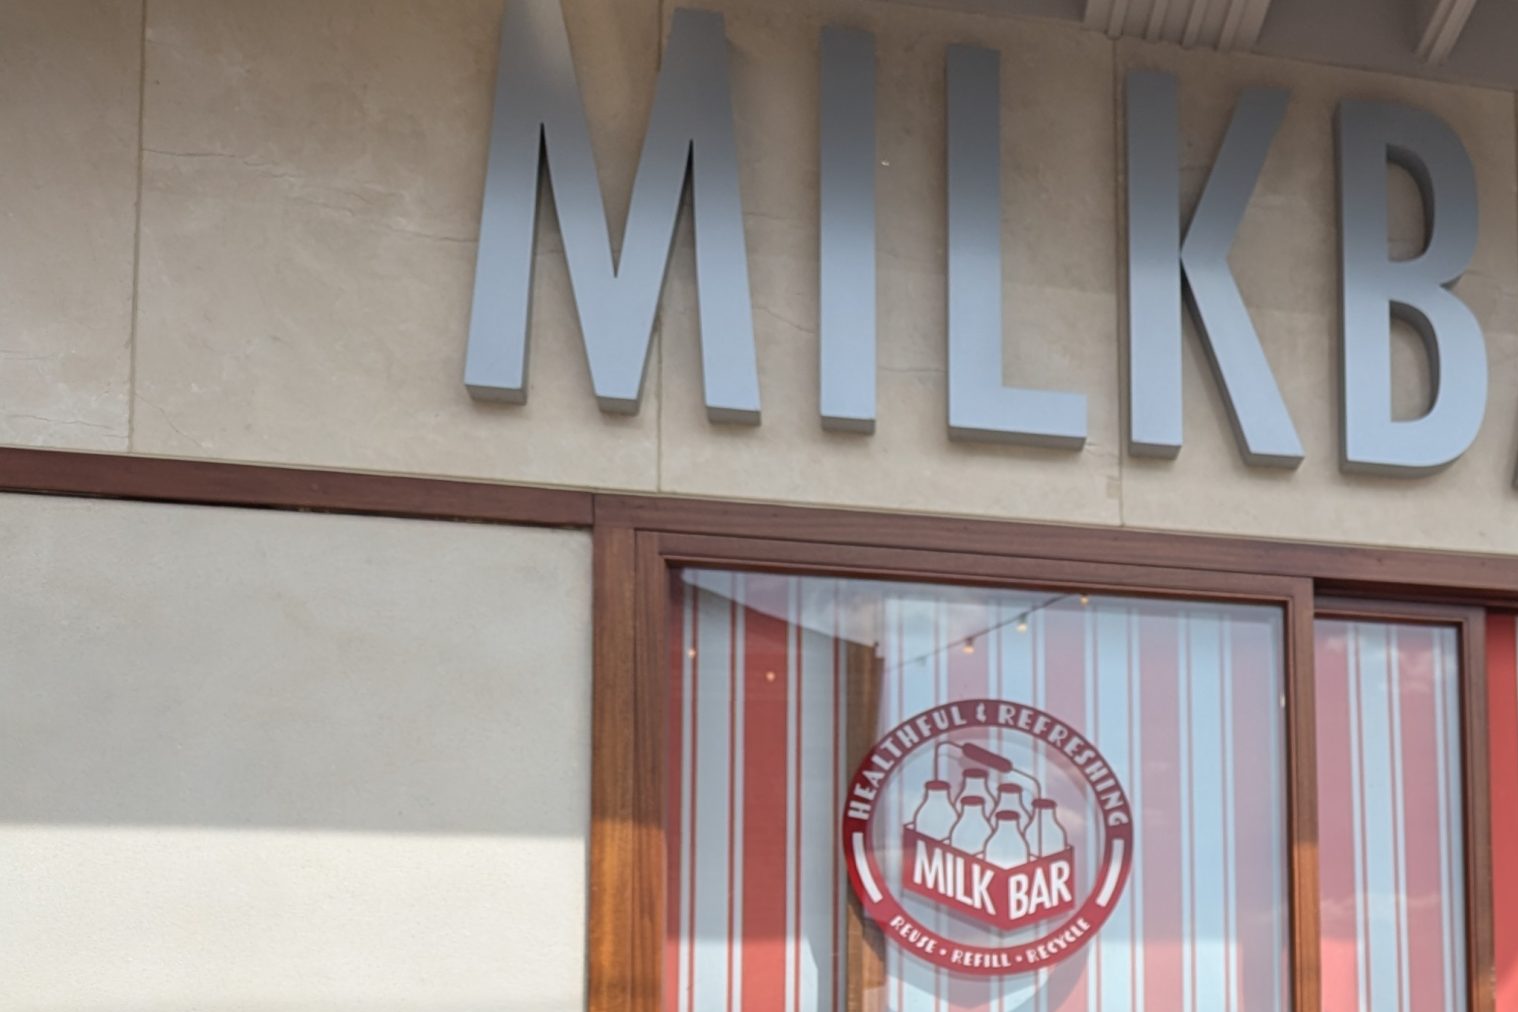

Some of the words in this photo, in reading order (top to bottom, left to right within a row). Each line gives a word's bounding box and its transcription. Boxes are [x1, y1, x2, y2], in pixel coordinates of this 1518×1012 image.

[847, 706, 967, 821] HEALTHFUL
[975, 703, 986, 722] &
[998, 703, 1129, 827] REFRESHING
[913, 840, 996, 916] MILK
[1008, 860, 1072, 920] BAR
[889, 915, 936, 954] REUSE
[951, 950, 1011, 968] REFILL
[1026, 917, 1090, 963] RECYCLE
